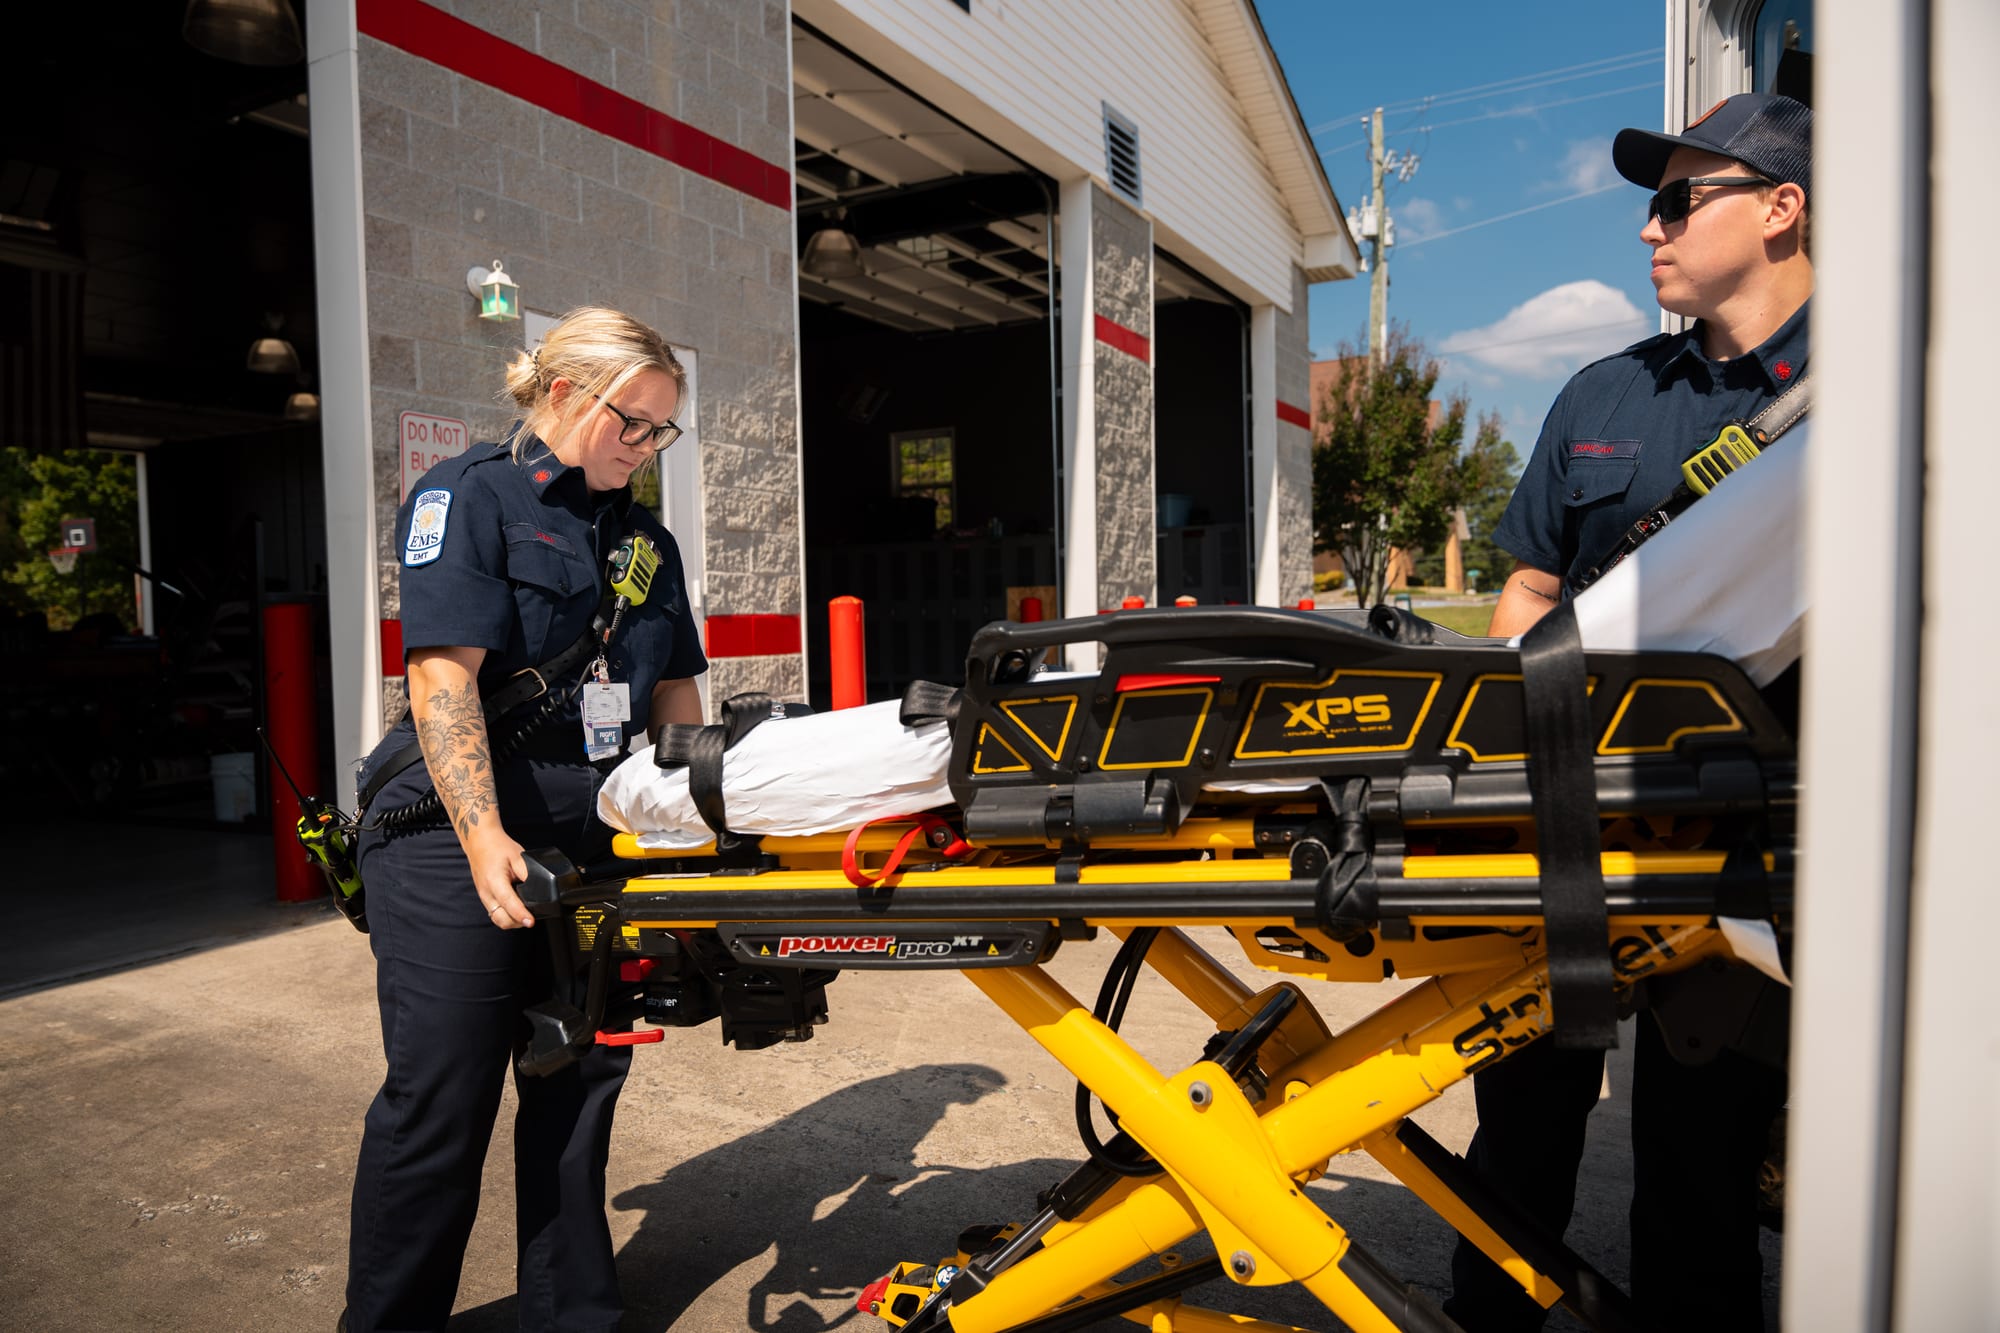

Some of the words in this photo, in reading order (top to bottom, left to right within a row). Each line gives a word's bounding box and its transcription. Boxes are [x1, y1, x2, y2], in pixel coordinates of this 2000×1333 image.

[408, 420, 427, 442] DO
[433, 424, 461, 447] NOT
[411, 451, 449, 472] BLO
[409, 532, 439, 548] EMS
[413, 552, 429, 561] EMT
[1281, 693, 1392, 731] XPS
[777, 935, 896, 957] power
[896, 940, 952, 959] pro
[952, 935, 984, 947] XT
[645, 997, 678, 1008] stryker
